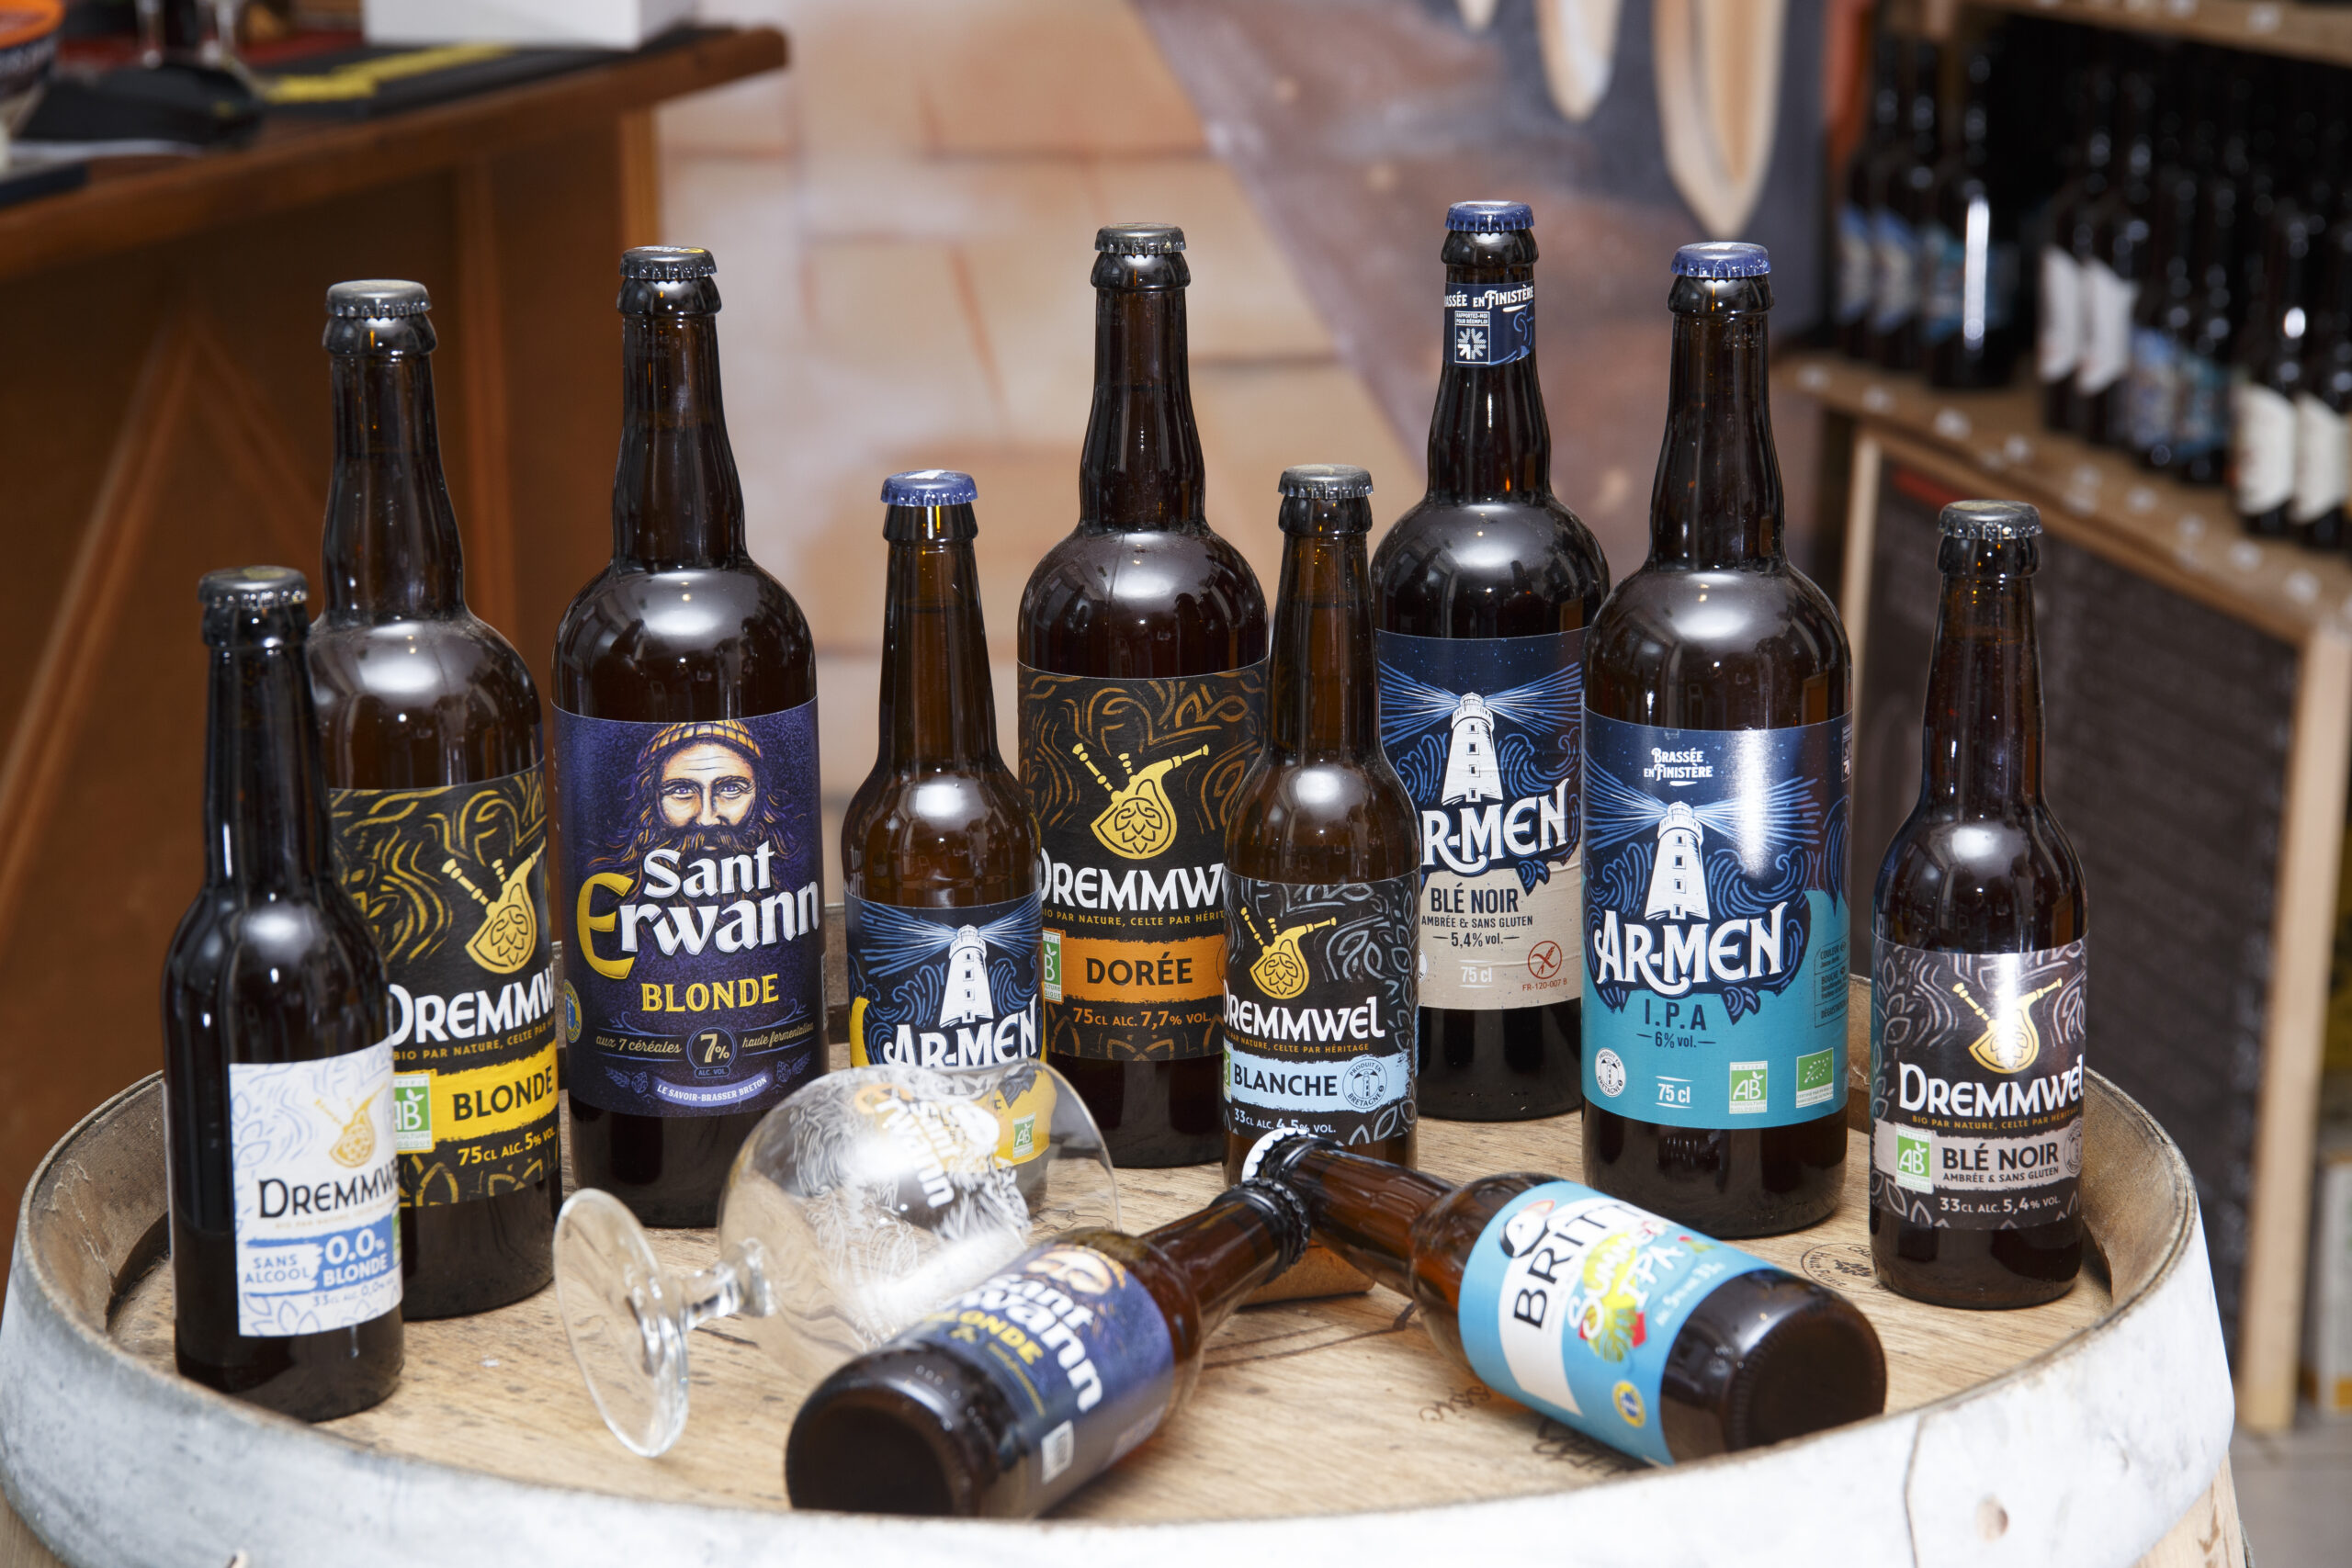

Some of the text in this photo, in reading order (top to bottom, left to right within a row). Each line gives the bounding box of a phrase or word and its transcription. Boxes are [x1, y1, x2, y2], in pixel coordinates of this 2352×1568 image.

[1473, 297, 1485, 307] EN
[1484, 284, 1533, 310] FINISTÈRE
[1651, 747, 1704, 763] BRASSÉE
[1654, 762, 1713, 781] FINISTÈRE
[1421, 778, 1571, 874] R-MEN
[644, 840, 777, 899] Sant
[1041, 847, 1226, 912] REMMW
[1430, 883, 1519, 914] BLÉ NOIR
[576, 871, 820, 981] Erwann
[1057, 911, 1074, 921] PAR
[1079, 914, 1125, 927] NATURE,
[1130, 917, 1164, 927] CELTE
[1170, 915, 1190, 925] PAR
[1196, 909, 1225, 922] HÉRIT
[1421, 915, 1533, 929] AMBRÉE & SANS GLUTEN
[1451, 931, 1504, 949] 5,4% vol.
[1594, 901, 1789, 996] AR-MEN
[1044, 953, 1056, 982] B
[1086, 952, 1193, 987] DORÉE
[1460, 966, 1493, 983] 75 cl
[640, 973, 779, 1013] BLONDE
[1113, 1013, 1137, 1027] ALC.
[1140, 1010, 1182, 1031] 7,7%
[1185, 1011, 1212, 1025] VOL.
[393, 1052, 416, 1061] BIO
[423, 1048, 448, 1060] PAR
[453, 1039, 504, 1056] NATURE,
[506, 1030, 534, 1046] CELTE
[596, 1034, 683, 1054] aux 7 céréales
[741, 1021, 814, 1049] haute fermentation
[1240, 1037, 1272, 1052] NATURE,
[1273, 1043, 1299, 1053] CELTE
[1303, 1045, 1320, 1054] PAR
[1325, 1043, 1370, 1054] HÉRITAGE
[1655, 1031, 1697, 1049] 6% vol.
[700, 1033, 730, 1064] 7%
[1234, 1063, 1338, 1097] BLANCHE
[1350, 1062, 1374, 1077] PRODUIT
[452, 1065, 553, 1122] BLONDE
[657, 1076, 768, 1102] LE SAVOIR-BRASSER BRETON
[1657, 1083, 1690, 1103] 75 cl
[1733, 1078, 1762, 1100] AB
[1256, 1119, 1274, 1131] ALC.
[1313, 1123, 1336, 1134] VOL.
[1912, 1114, 1928, 1125] BIO
[1931, 1118, 1950, 1128] PAR
[1953, 1121, 1998, 1131] NATURE,
[2001, 1120, 2028, 1129] CELTE
[2032, 1116, 2049, 1126] PAR
[502, 1141, 524, 1158] ALC.
[525, 1132, 542, 1150] 5%
[1942, 1143, 1989, 1171] BLÉ
[1998, 1141, 2059, 1171] NOIR
[1898, 1148, 1926, 1175] AB
[1942, 1166, 2059, 1184] AMBRÉE & SANS GLUTEN
[1977, 1202, 2000, 1213] ALC.
[2003, 1197, 2040, 1215] 5,4%
[2042, 1196, 2061, 1207] VOL.
[253, 1253, 299, 1269] SANS
[322, 1253, 388, 1288] BLONDE
[243, 1267, 311, 1284] ALCOOL
[923, 1309, 1044, 1365] ONDE
